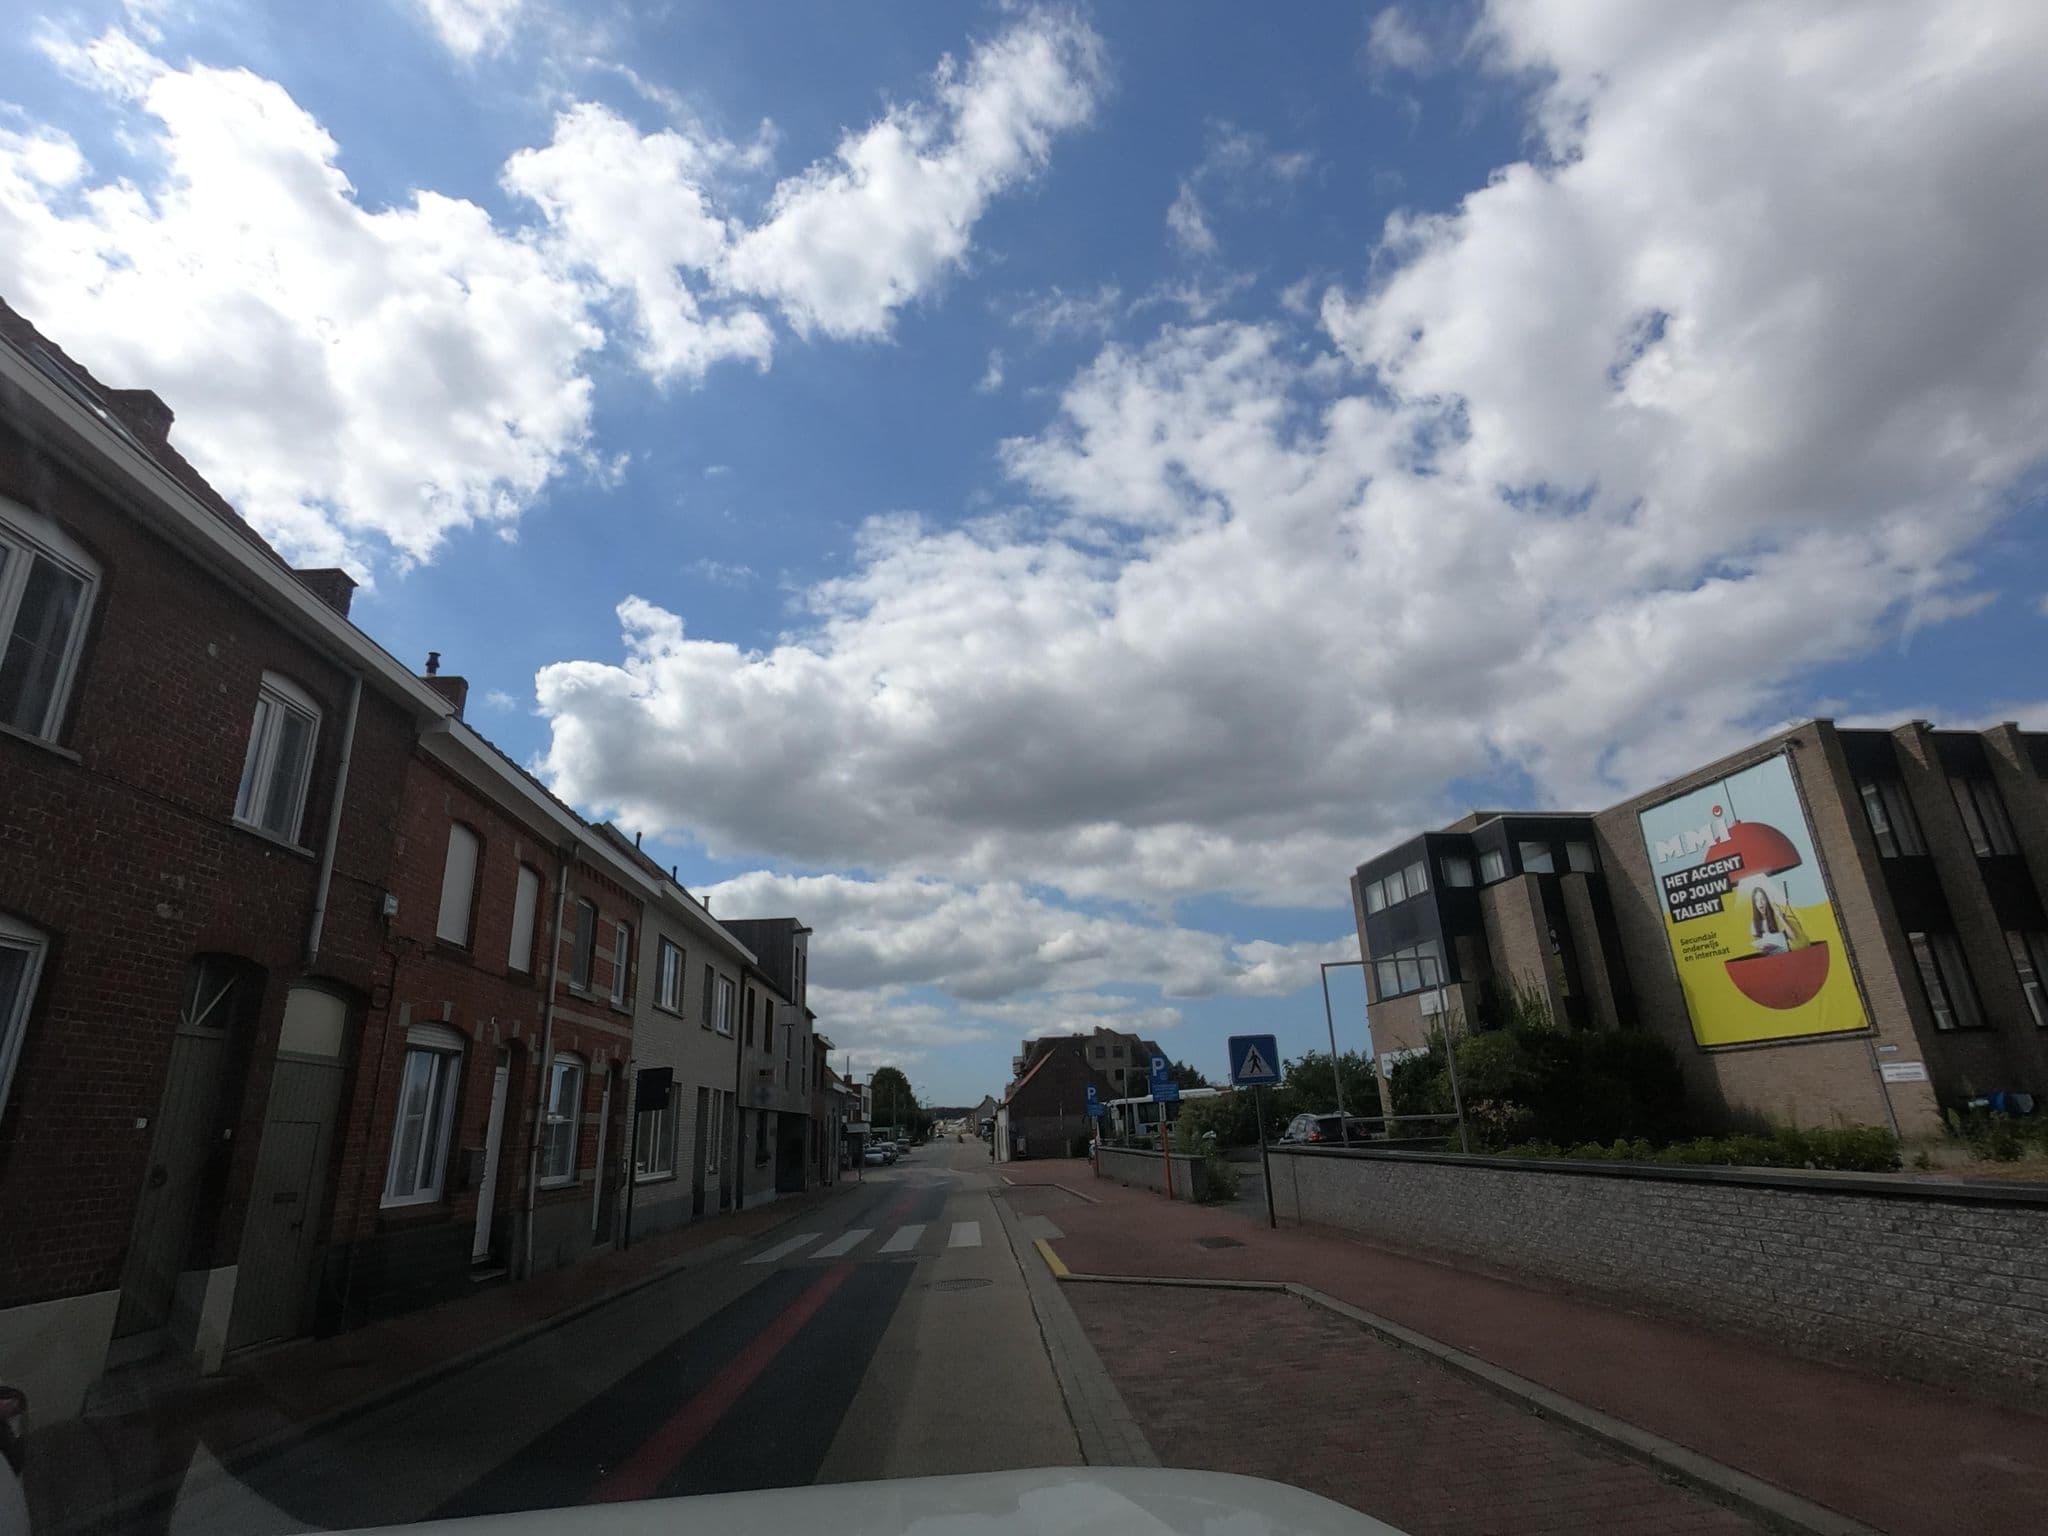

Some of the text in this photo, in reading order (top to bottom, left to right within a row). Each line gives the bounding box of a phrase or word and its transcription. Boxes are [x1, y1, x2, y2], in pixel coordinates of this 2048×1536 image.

[1665, 855, 1741, 889] HET ACCENT
[1670, 878, 1728, 904] OP JOUW
[1673, 899, 1720, 920] TALENT
[1680, 931, 1717, 945] Secundair
[1682, 940, 1719, 953] onderwijs
[1695, 947, 1730, 960] internaat
[1152, 1057, 1165, 1076] P
[1088, 1086, 1096, 1100] P
